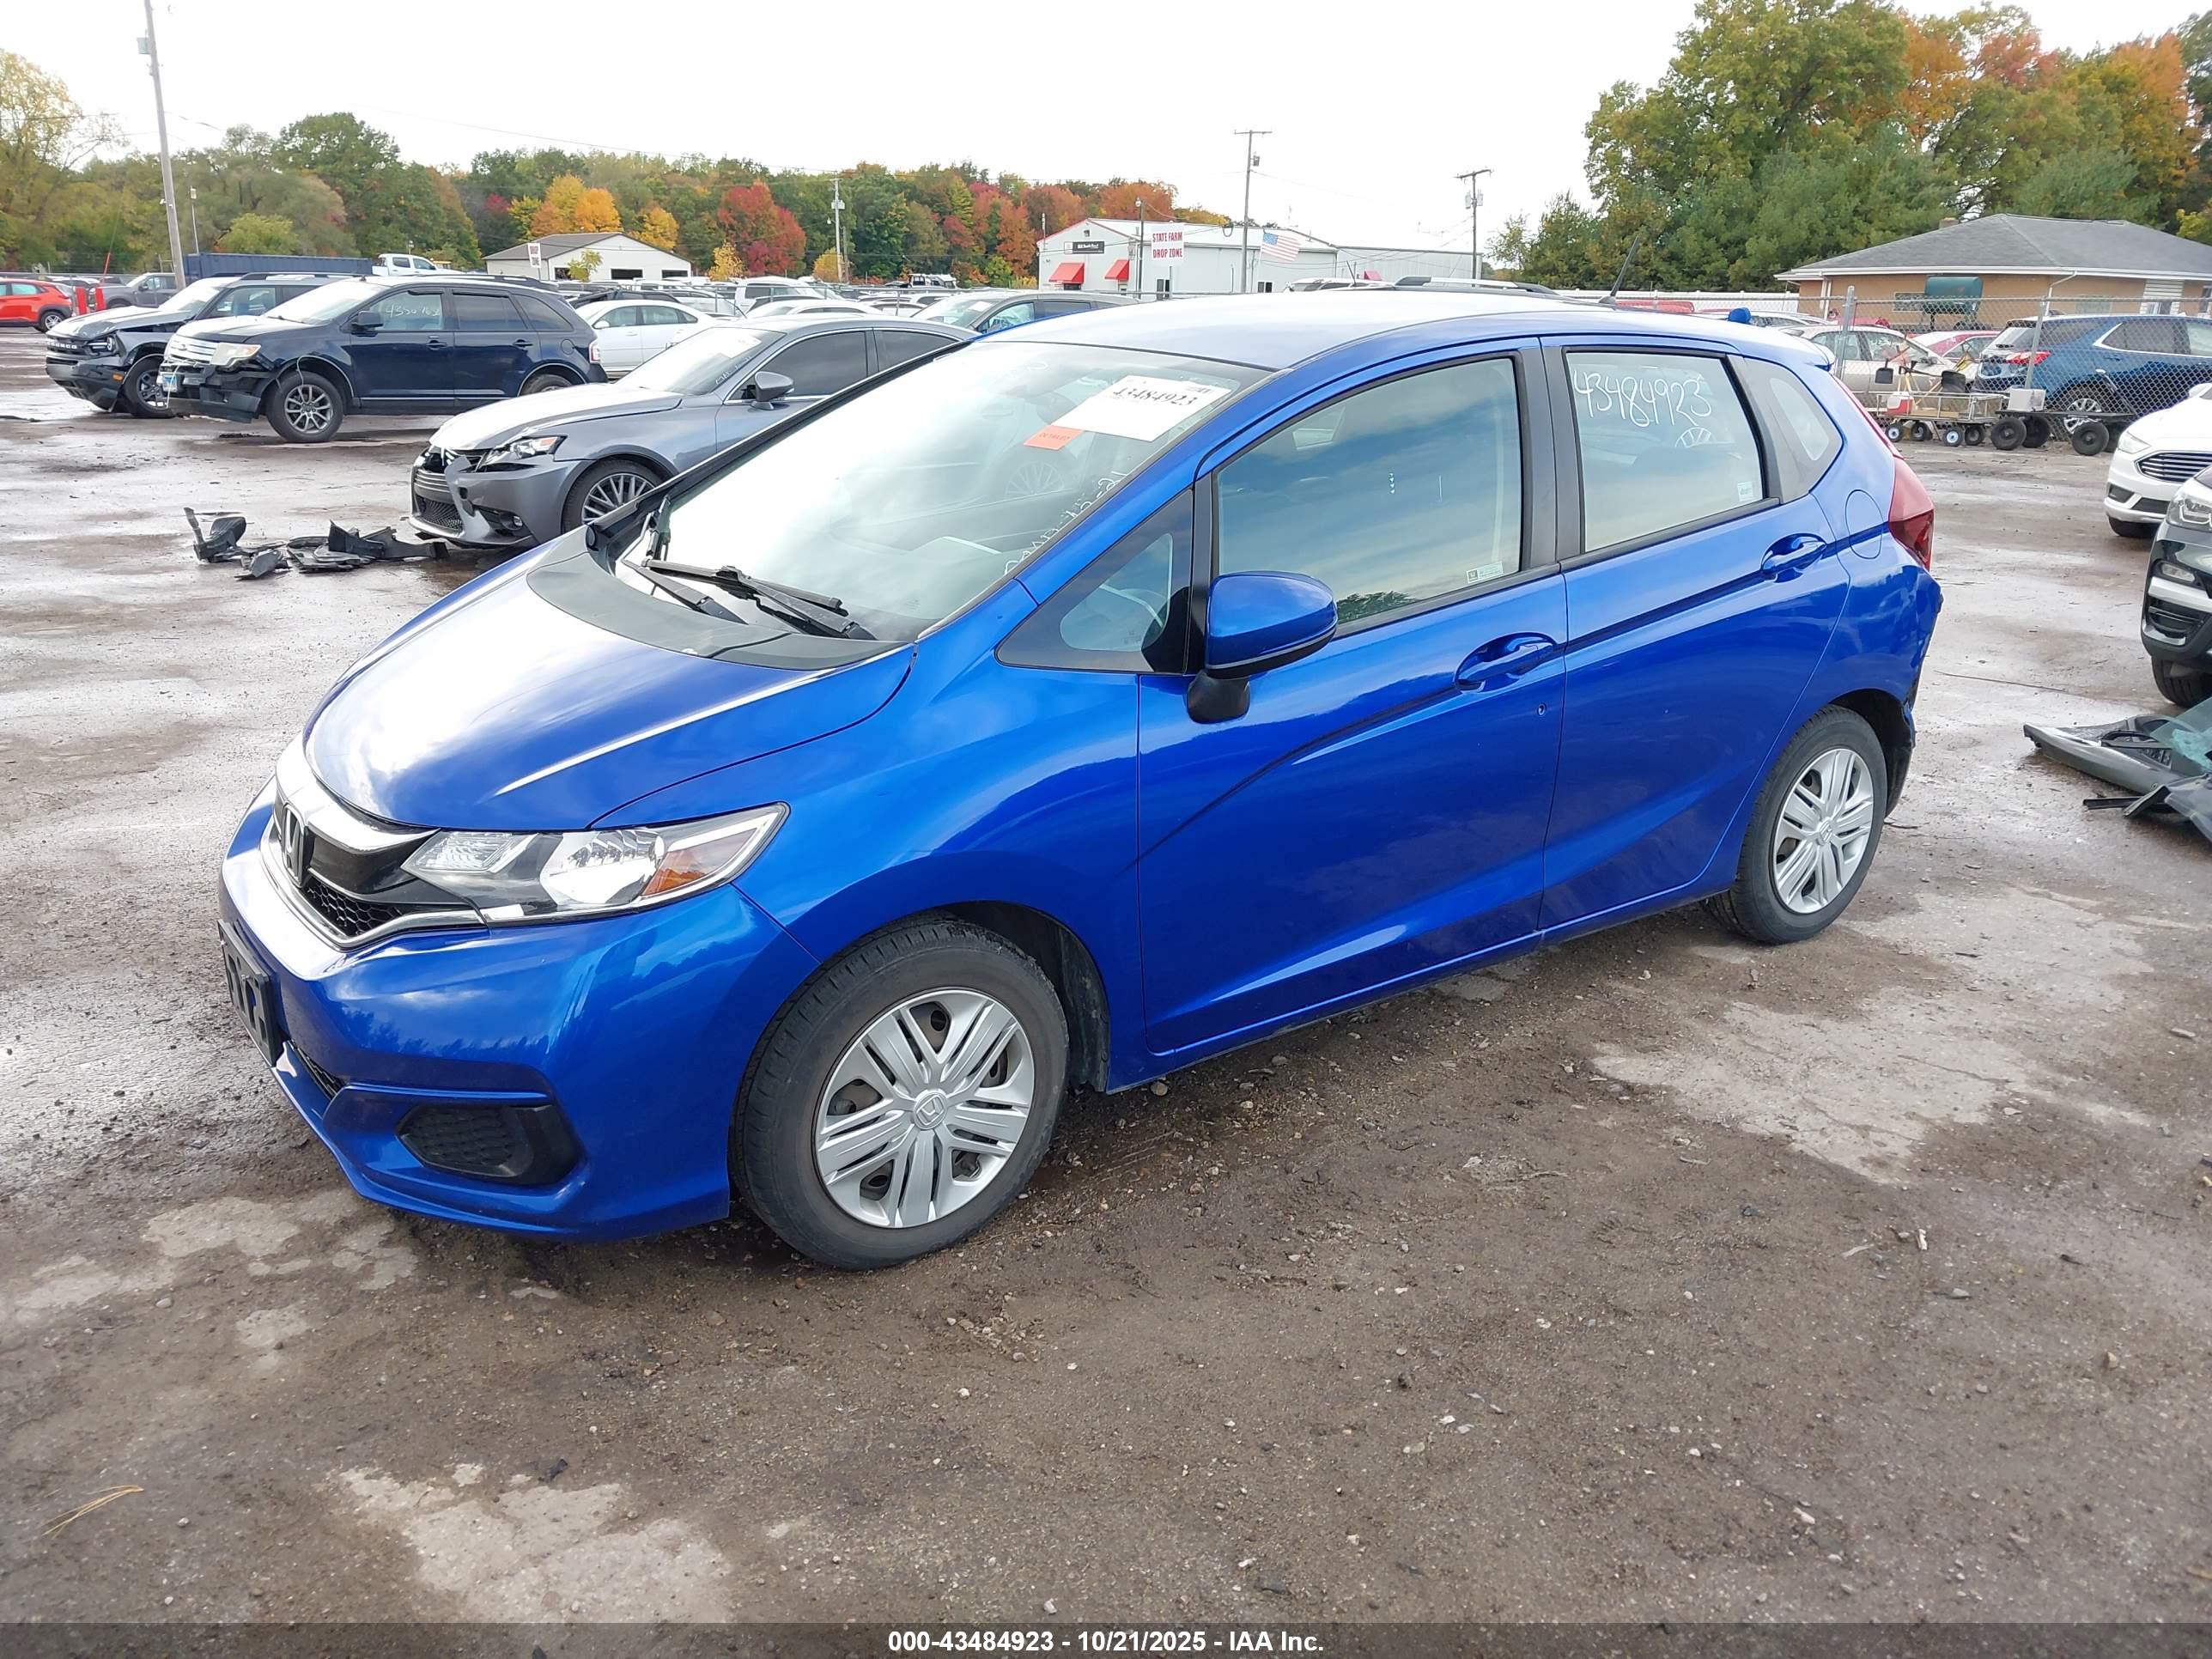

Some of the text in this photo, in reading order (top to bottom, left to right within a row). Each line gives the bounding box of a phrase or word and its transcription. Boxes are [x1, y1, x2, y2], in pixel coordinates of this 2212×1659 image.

[1152, 232, 1182, 242] STATE FARM
[1152, 248, 1182, 258] DROP ZONE
[1113, 387, 1198, 406] 43484923
[1574, 369, 1712, 428] 43484923
